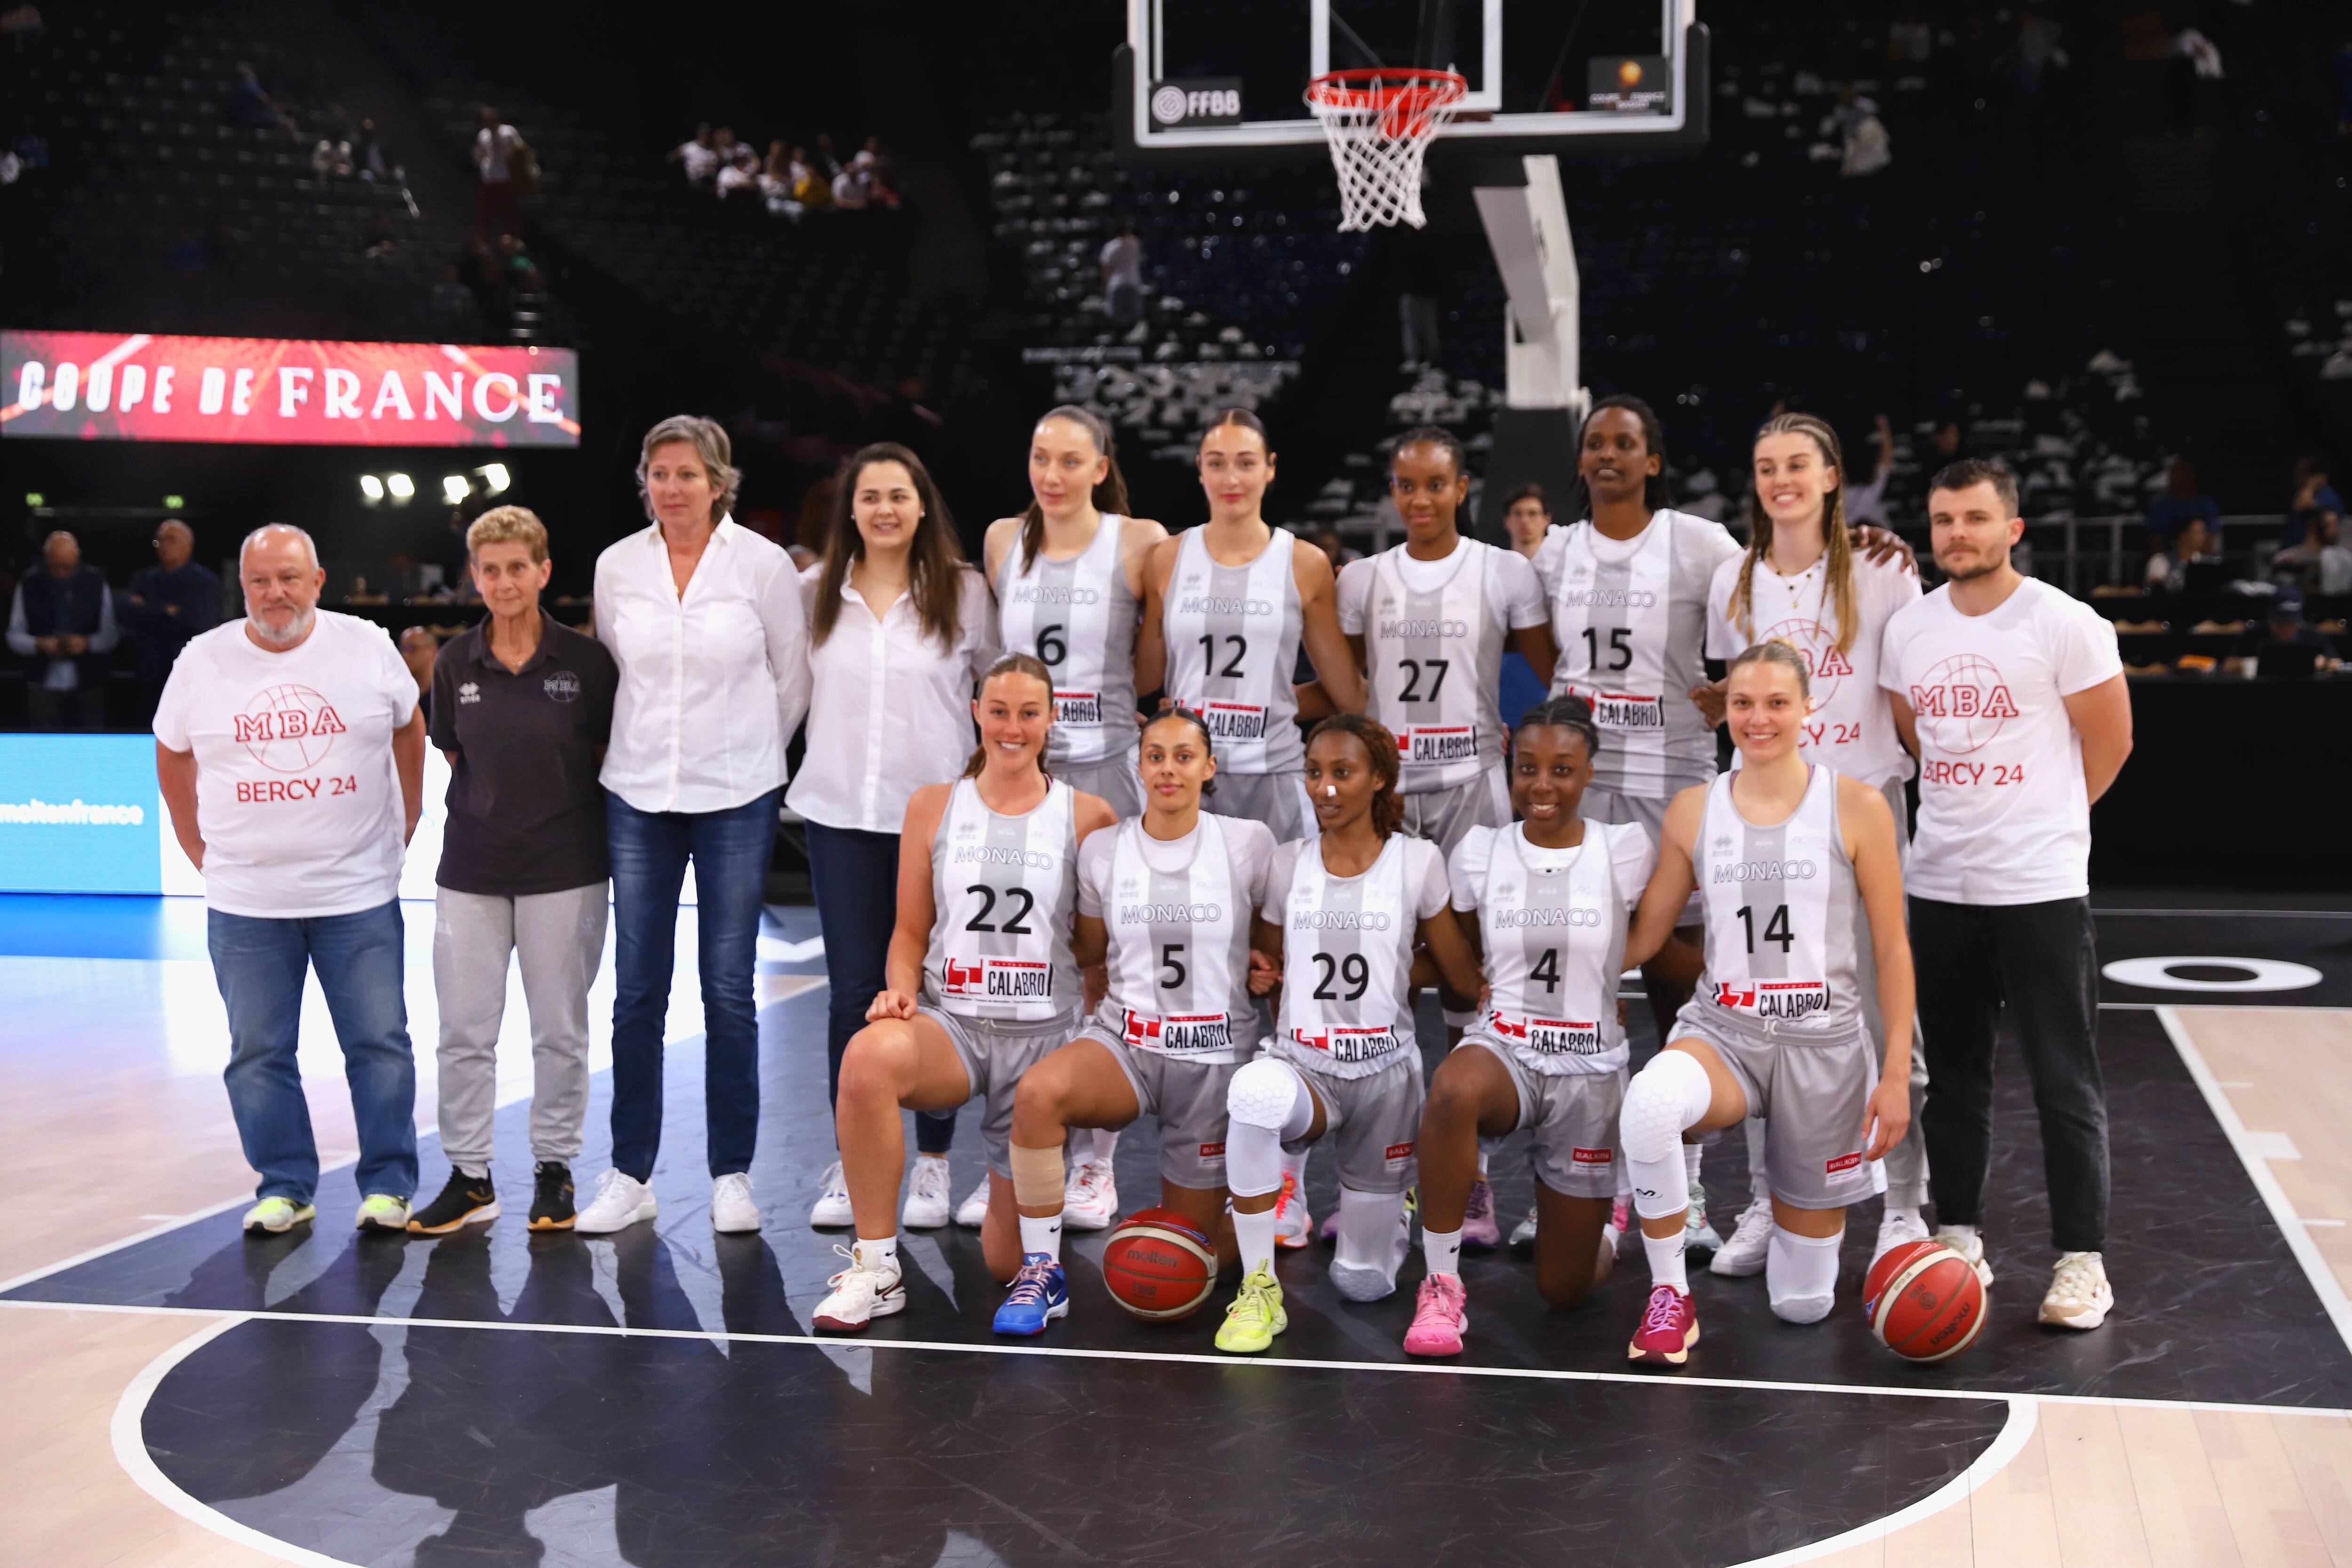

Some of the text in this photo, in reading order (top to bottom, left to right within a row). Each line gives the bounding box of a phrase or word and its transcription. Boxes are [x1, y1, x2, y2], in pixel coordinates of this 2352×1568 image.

[18, 360, 564, 423] COUPE DE FRANCE
[1013, 586, 1099, 605] MONACO
[1180, 597, 1273, 615] MONACO
[1566, 589, 1657, 607] MONACO
[1381, 620, 1469, 638] MONACO
[1037, 623, 1066, 666] 6
[1199, 634, 1247, 678] 12
[1582, 627, 1632, 670] 15
[544, 679, 580, 692] MBA
[1398, 659, 1449, 701] 27
[1599, 702, 1657, 726] CALABRO
[1911, 685, 2020, 718] MBA
[234, 707, 346, 742] MBA
[1208, 711, 1262, 738] CALABRO
[1834, 722, 1860, 744] 24
[1414, 735, 1472, 761] CALABRO
[1993, 763, 2025, 786] 24
[237, 774, 357, 802] BERCY 24
[954, 845, 1053, 869] MONACO
[1714, 860, 1817, 883] MONACO
[966, 883, 1034, 934] 22
[1121, 903, 1222, 924] MONACO
[1294, 910, 1391, 931] MONACO
[1495, 908, 1601, 929] MONACO
[1736, 904, 1794, 954] 14
[1160, 943, 1186, 989] 5
[1312, 952, 1369, 1001] 29
[1530, 948, 1561, 993] 4
[988, 970, 1046, 996] CALABRO
[1759, 992, 1823, 1018] CALABRO
[1166, 1024, 1225, 1049] CALABRO
[1335, 1035, 1394, 1061] CALABRO
[1532, 1029, 1594, 1054] CALABRO
[1127, 1249, 1178, 1268] molten
[1931, 1302, 1971, 1345] molten
